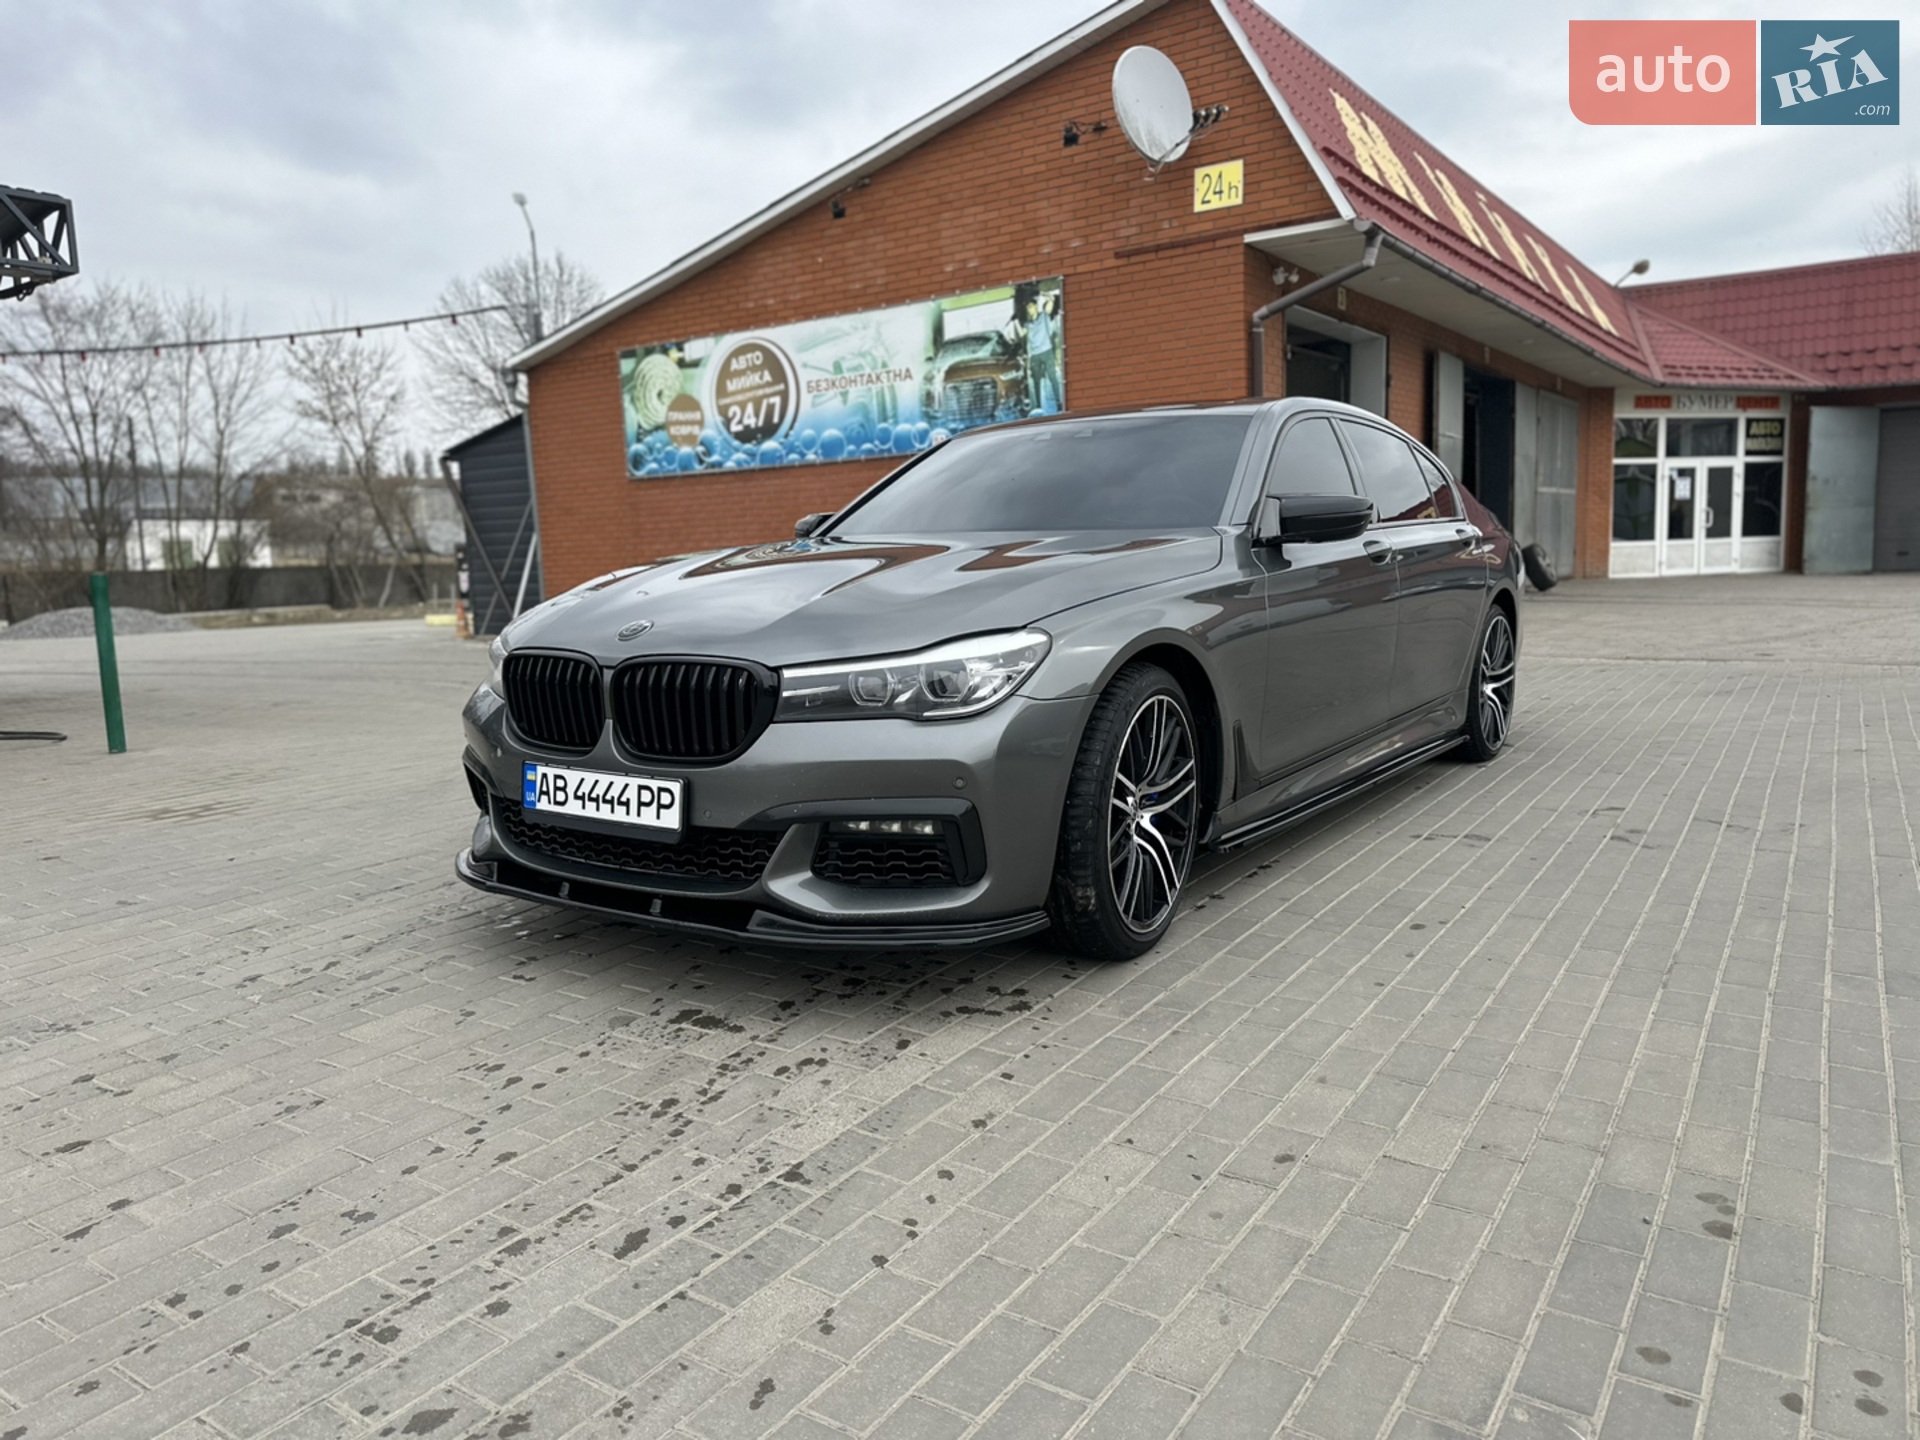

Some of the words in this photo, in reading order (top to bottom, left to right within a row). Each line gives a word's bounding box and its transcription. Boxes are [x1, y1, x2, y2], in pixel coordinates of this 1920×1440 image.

[1201, 170, 1224, 206] 24
[729, 351, 764, 373] АВТО
[725, 370, 773, 393] МИЙКА
[806, 367, 914, 395] БЕЗКОНТАКТНА
[728, 396, 782, 433] 24/7
[537, 772, 569, 807] AB
[573, 777, 631, 816] 4444
[637, 784, 676, 820] PP
